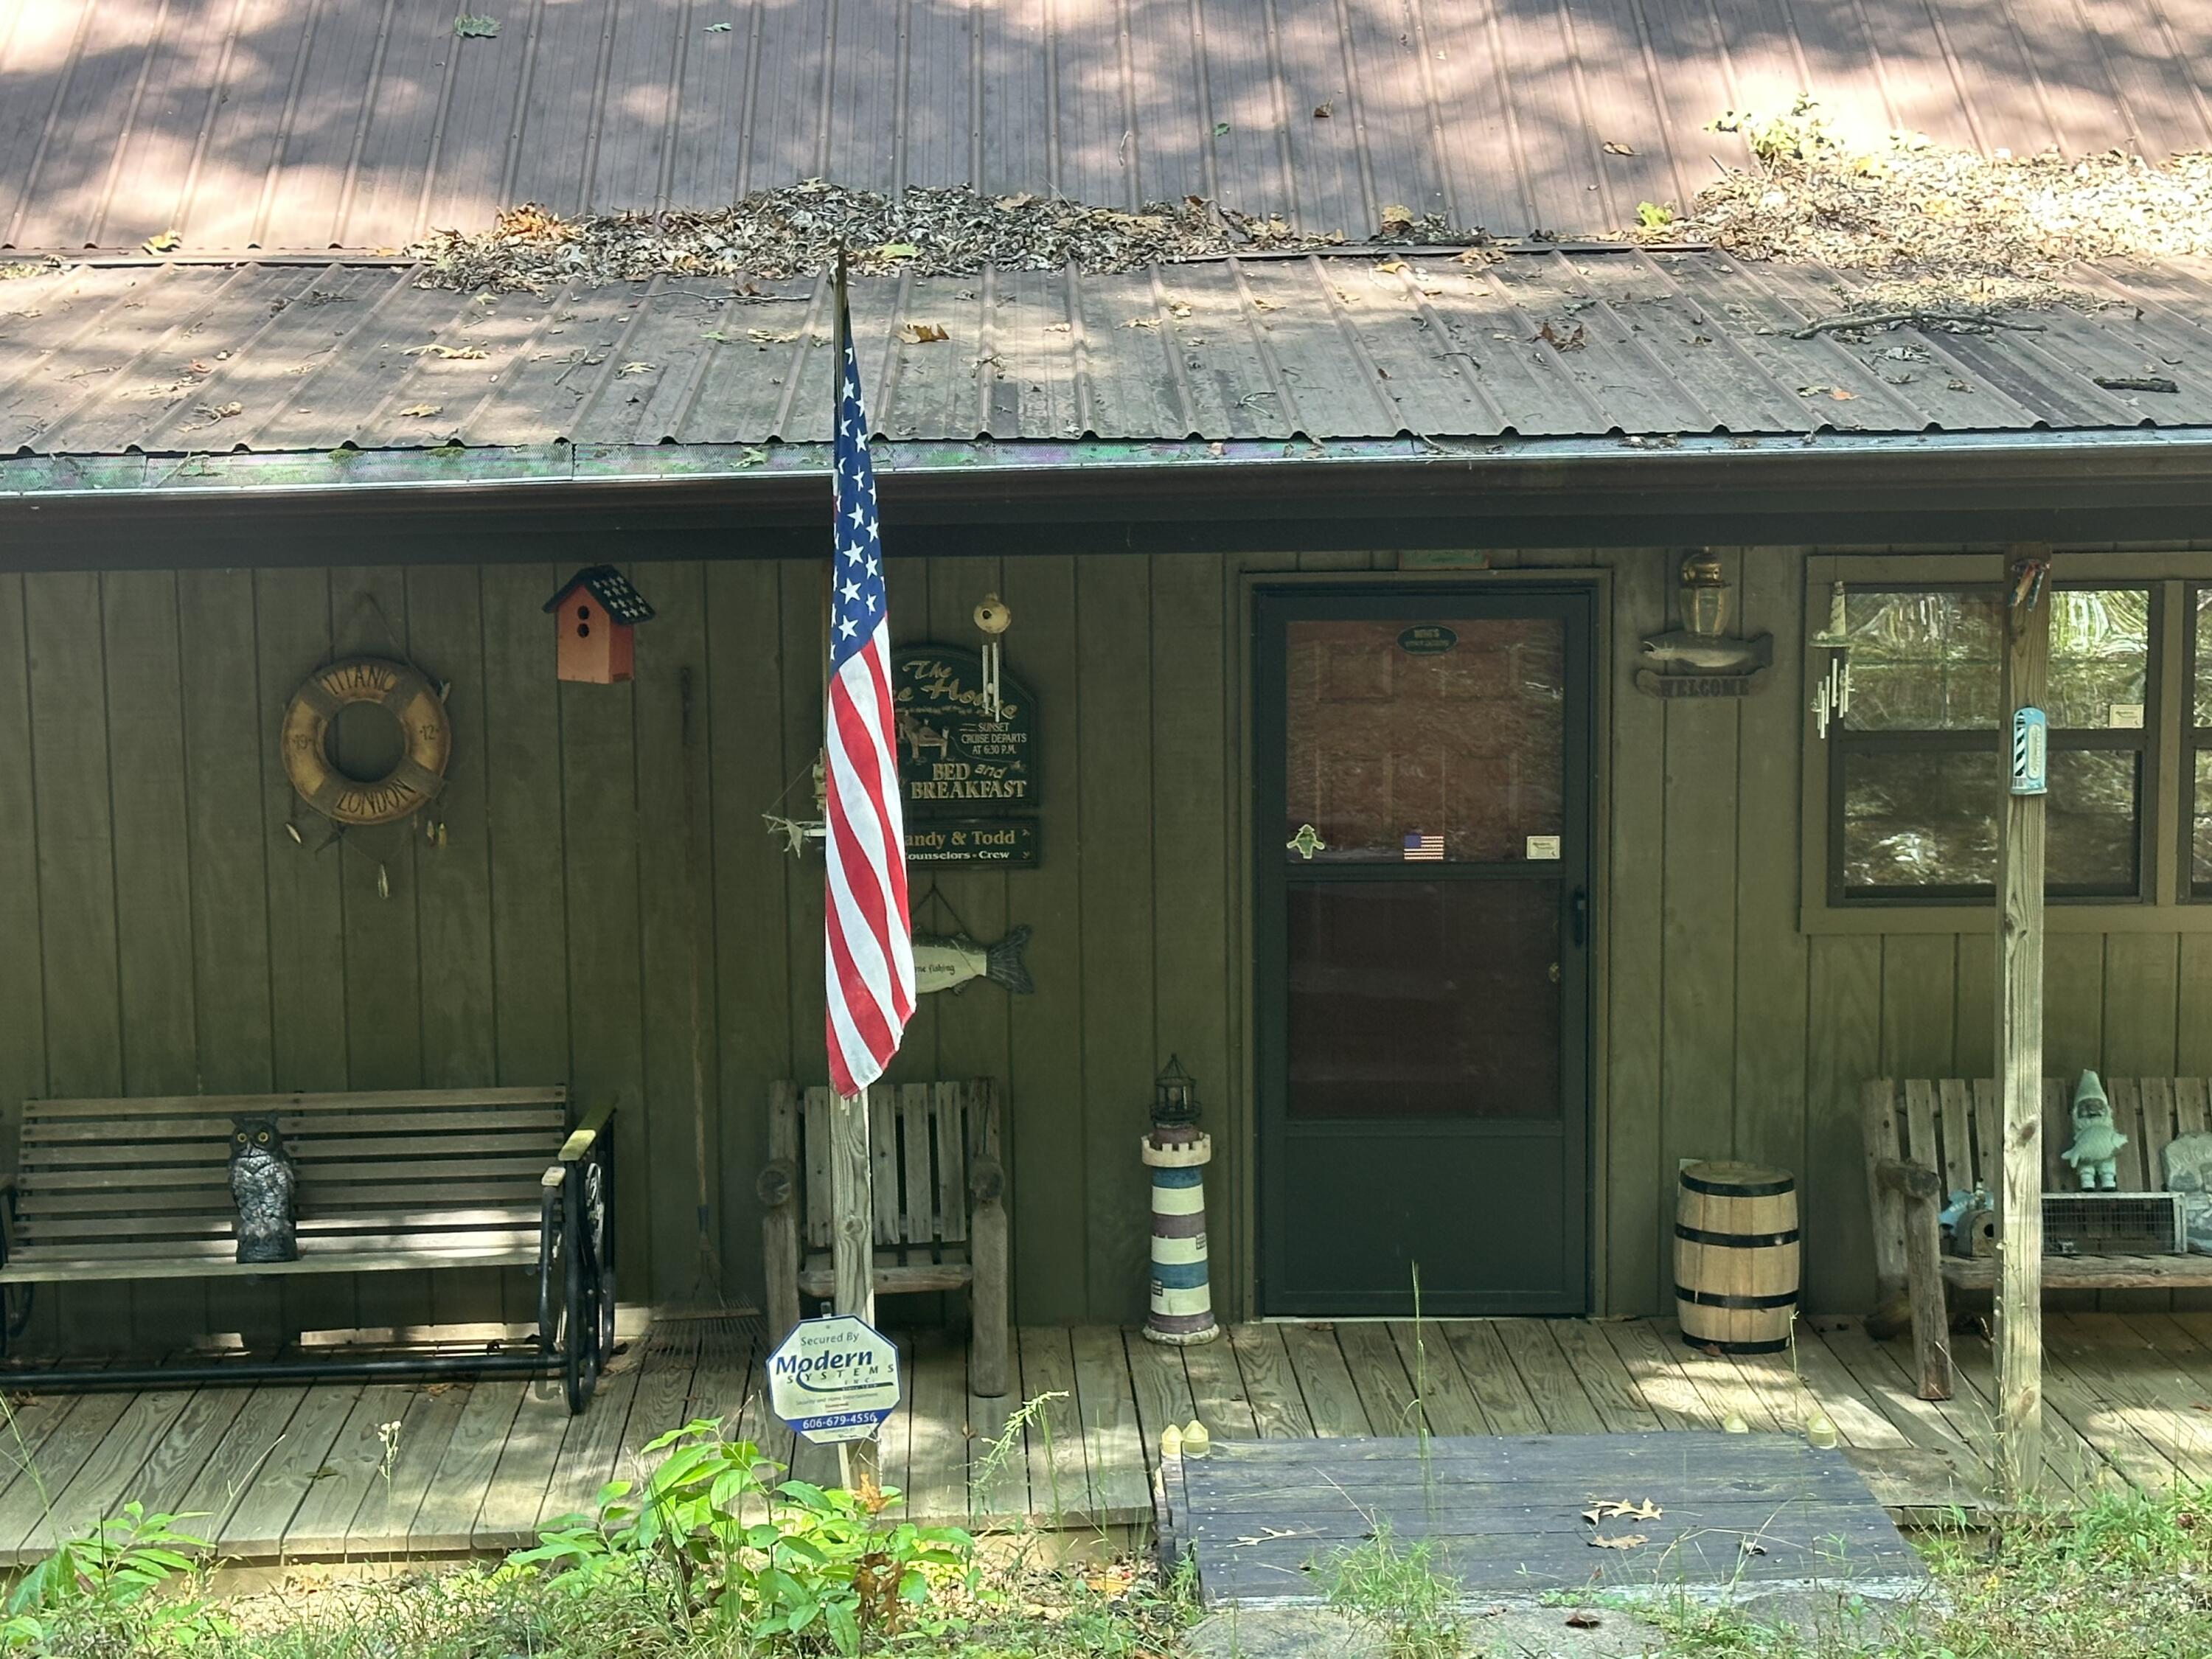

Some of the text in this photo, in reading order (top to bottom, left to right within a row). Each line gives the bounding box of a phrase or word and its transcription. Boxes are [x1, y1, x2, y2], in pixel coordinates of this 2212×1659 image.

[902, 661, 952, 679] The
[1658, 678, 1750, 698] WELCOME
[978, 723, 1009, 732] SUNSET
[961, 733, 1027, 744] CRUISE DEPARTS
[973, 745, 981, 754] AT
[932, 763, 1007, 781] BED and
[336, 778, 417, 815] LONDON
[911, 780, 1027, 799] BREAKFAST
[904, 830, 1015, 849] andy & Todd
[906, 850, 1010, 860] ounselors Crew
[800, 1332, 860, 1346] Secured By
[775, 1350, 873, 1375] Modern
[787, 1364, 895, 1385] SYSTEMS
[802, 1412, 876, 1429] 606-679-4556
